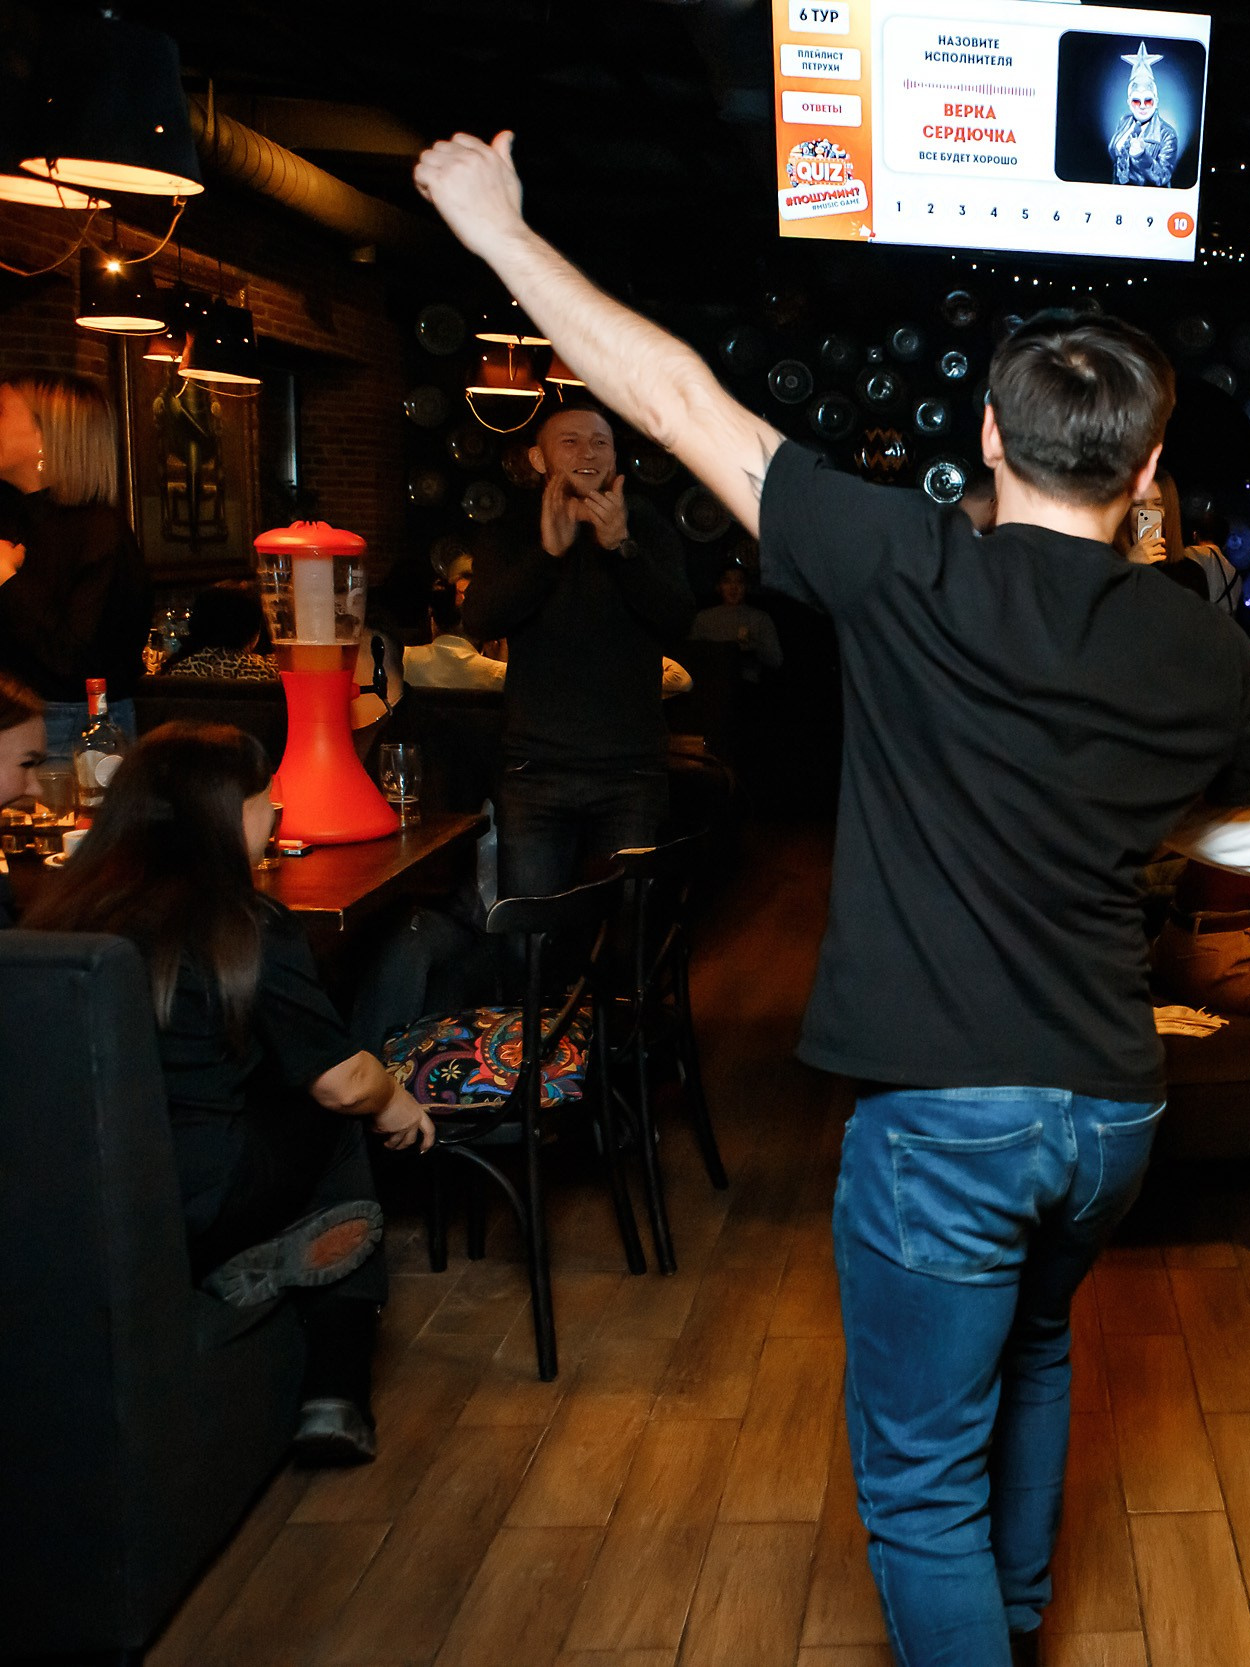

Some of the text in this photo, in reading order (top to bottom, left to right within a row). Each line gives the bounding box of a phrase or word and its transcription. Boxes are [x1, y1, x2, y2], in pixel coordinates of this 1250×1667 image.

[799, 8, 839, 23] 6 ТУР
[938, 35, 1000, 49] НАЗОВИТЕ
[797, 49, 843, 60] ПЛЕЙЛИСТ
[925, 51, 1013, 67] ИСПОЛНИТЕЛЯ
[802, 62, 840, 72] ПЕТРУХИ
[802, 103, 842, 114] ОТВЕТЫ
[944, 103, 997, 120] ВЕРКА
[923, 125, 1017, 144] СЕРДЮЧКА
[919, 151, 1018, 166] ВСЕ БУДЕТ ХОРОШО
[797, 161, 844, 182] QUIZ
[812, 197, 860, 211] #MUSIC GAME
[896, 200, 1188, 231] 1 2 3 4 5 6 7 8 9 10
